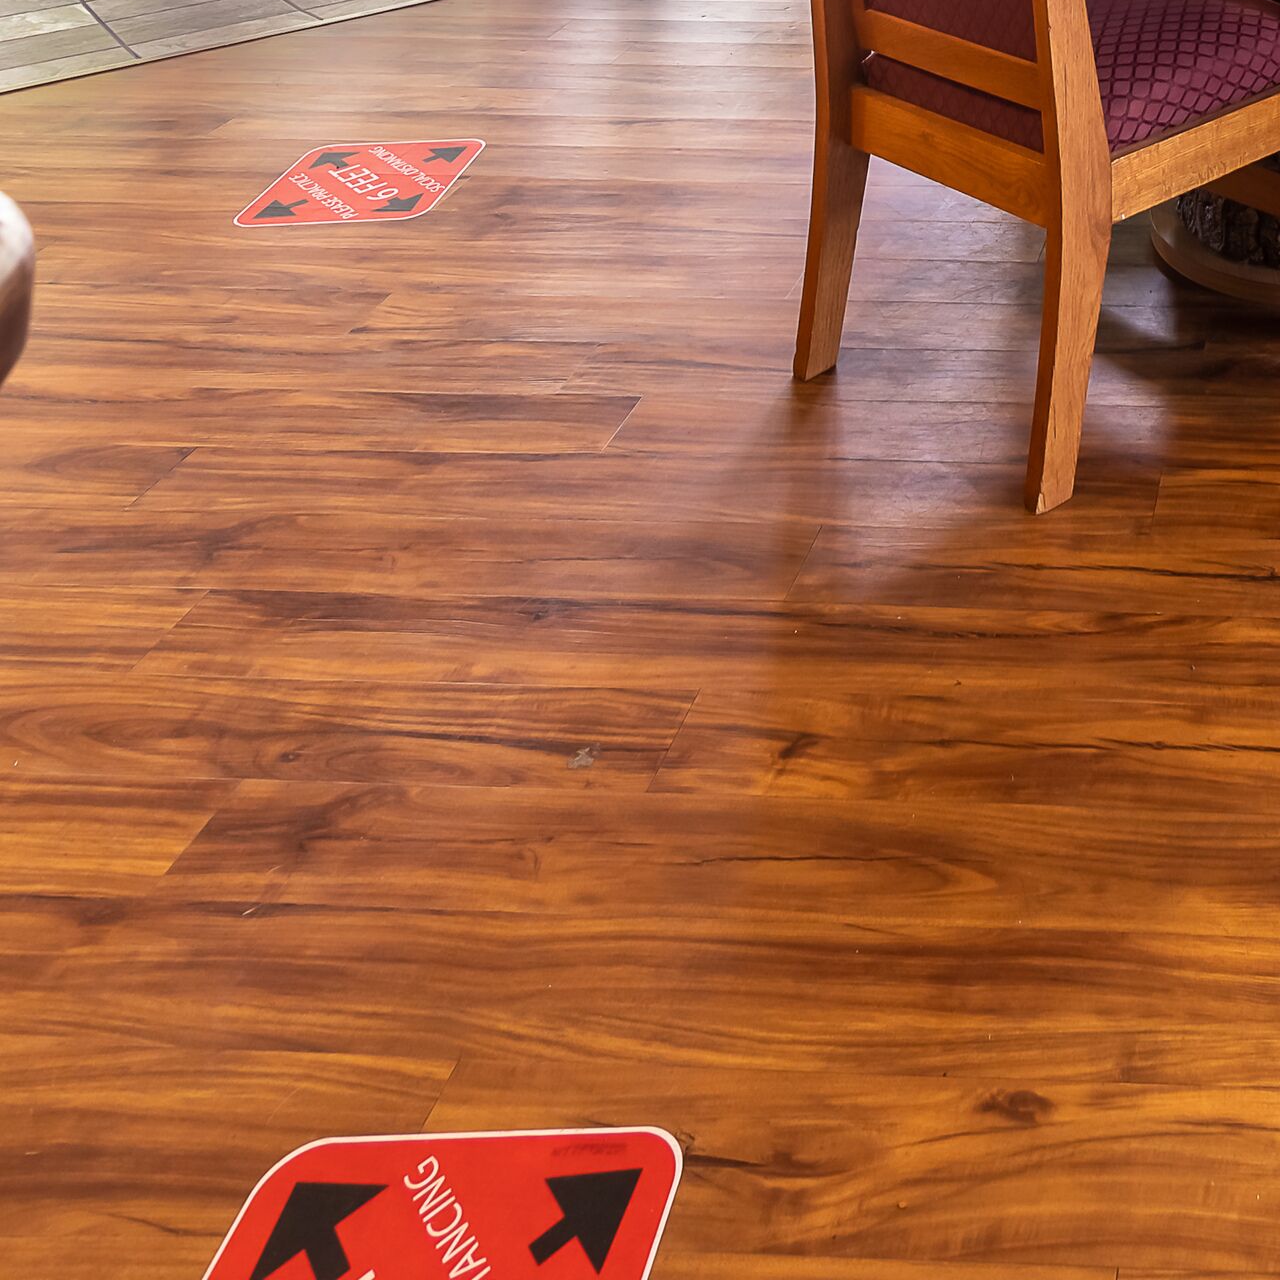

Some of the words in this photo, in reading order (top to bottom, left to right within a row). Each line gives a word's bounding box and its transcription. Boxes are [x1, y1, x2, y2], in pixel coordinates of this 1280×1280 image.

[367, 145, 420, 176] DISTANCING
[288, 172, 329, 204] PRACTICE
[327, 163, 381, 195] FEET
[411, 167, 446, 193] SOCIAL
[322, 194, 359, 220] PLEASE
[373, 187, 400, 202] 6
